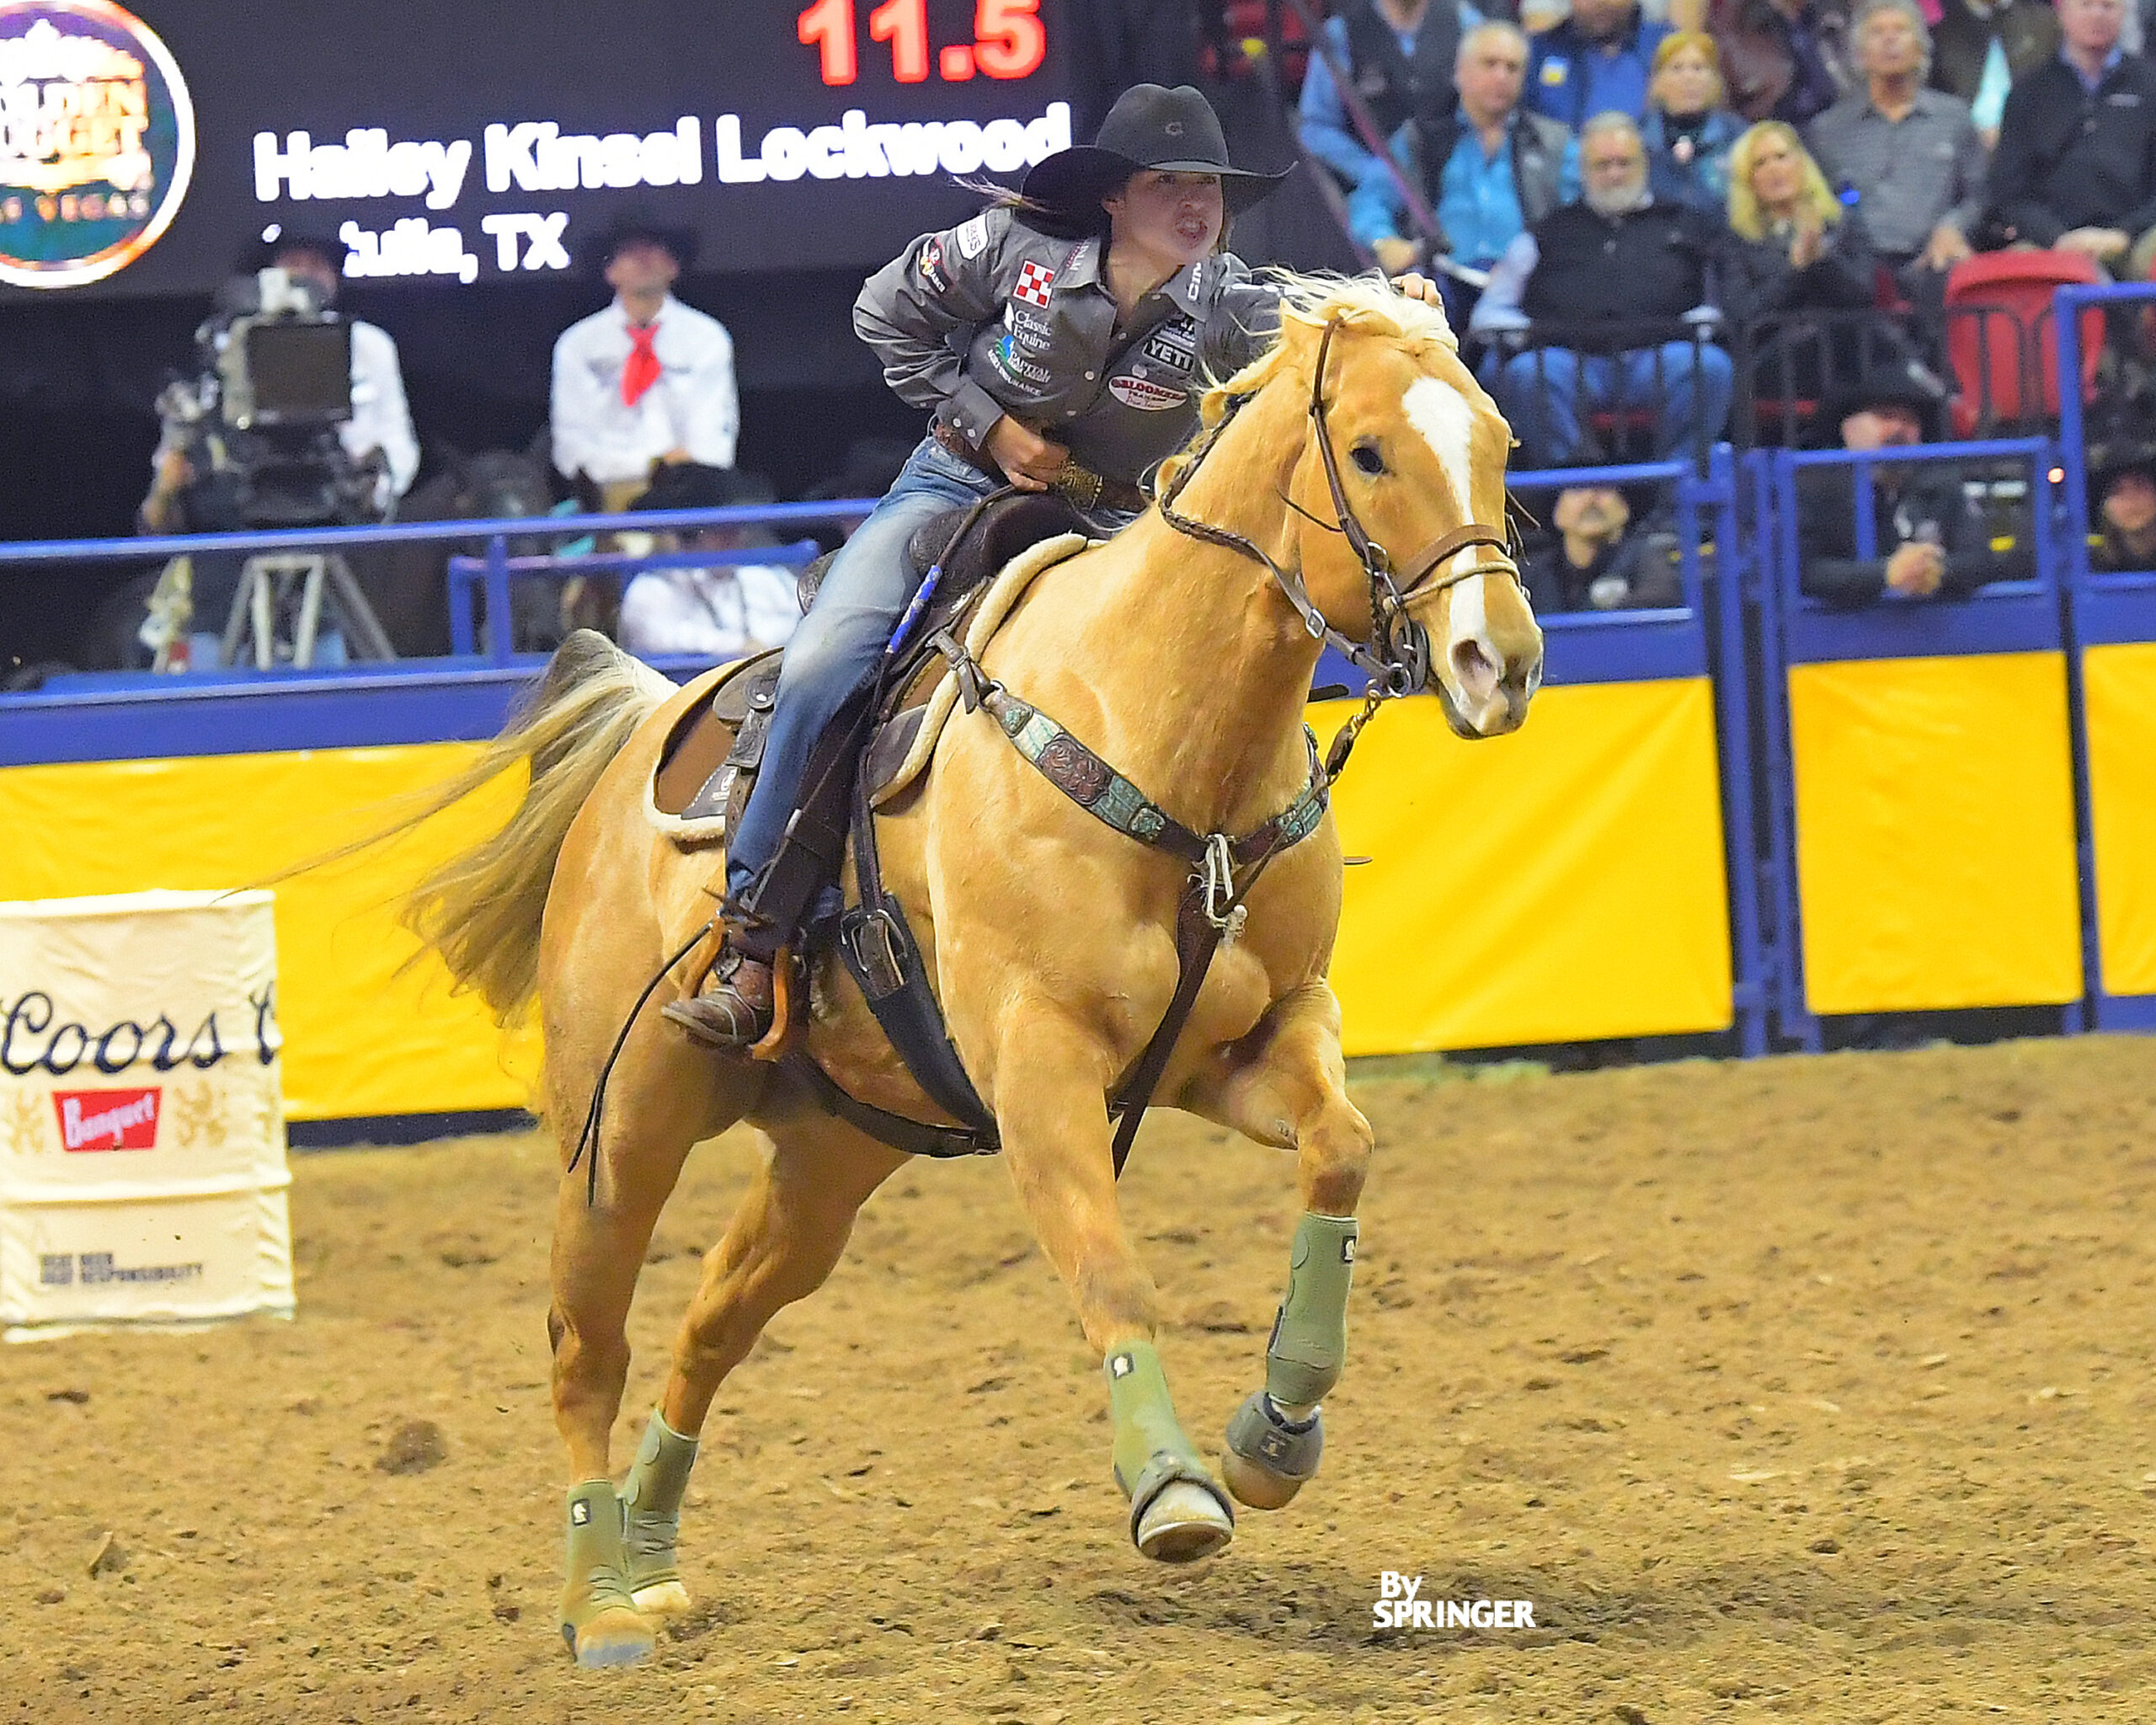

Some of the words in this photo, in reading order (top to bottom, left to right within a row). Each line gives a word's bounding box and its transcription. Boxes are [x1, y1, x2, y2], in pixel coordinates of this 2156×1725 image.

[797, 0, 1046, 86] 11.5
[253, 127, 472, 209] Hailey
[484, 120, 702, 192] Kinsel
[716, 101, 1071, 182] Lockwood
[482, 211, 571, 271] TX
[1013, 323, 1051, 350] Equine
[1015, 310, 1052, 336] Classic
[1150, 339, 1191, 369] YETI
[2, 992, 228, 1076] Coors
